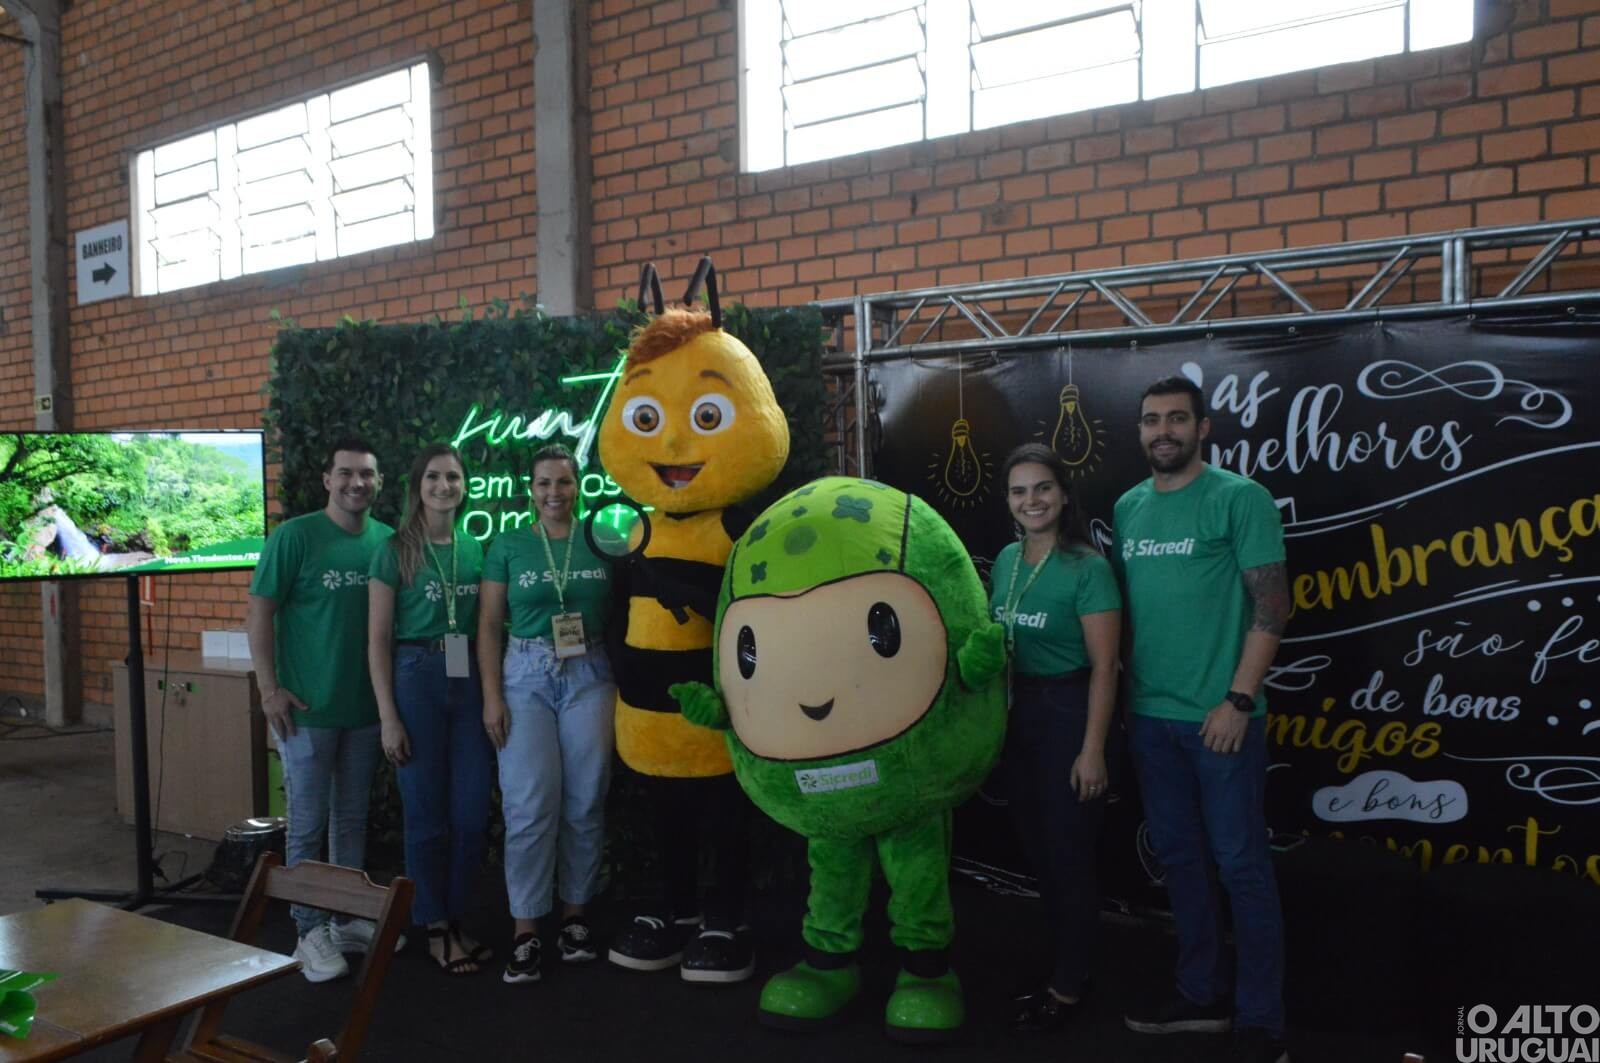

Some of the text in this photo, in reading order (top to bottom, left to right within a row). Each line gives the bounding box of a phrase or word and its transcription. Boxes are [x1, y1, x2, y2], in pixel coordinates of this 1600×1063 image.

[82, 235, 122, 260] BANHEIRO
[1210, 384, 1473, 477] melhores
[1135, 538, 1195, 556] Sicredi
[1287, 493, 1600, 618] embrança
[1404, 621, 1524, 667] são
[1350, 669, 1522, 721] de bons
[1265, 697, 1443, 773] migos
[1361, 777, 1458, 818] bons
